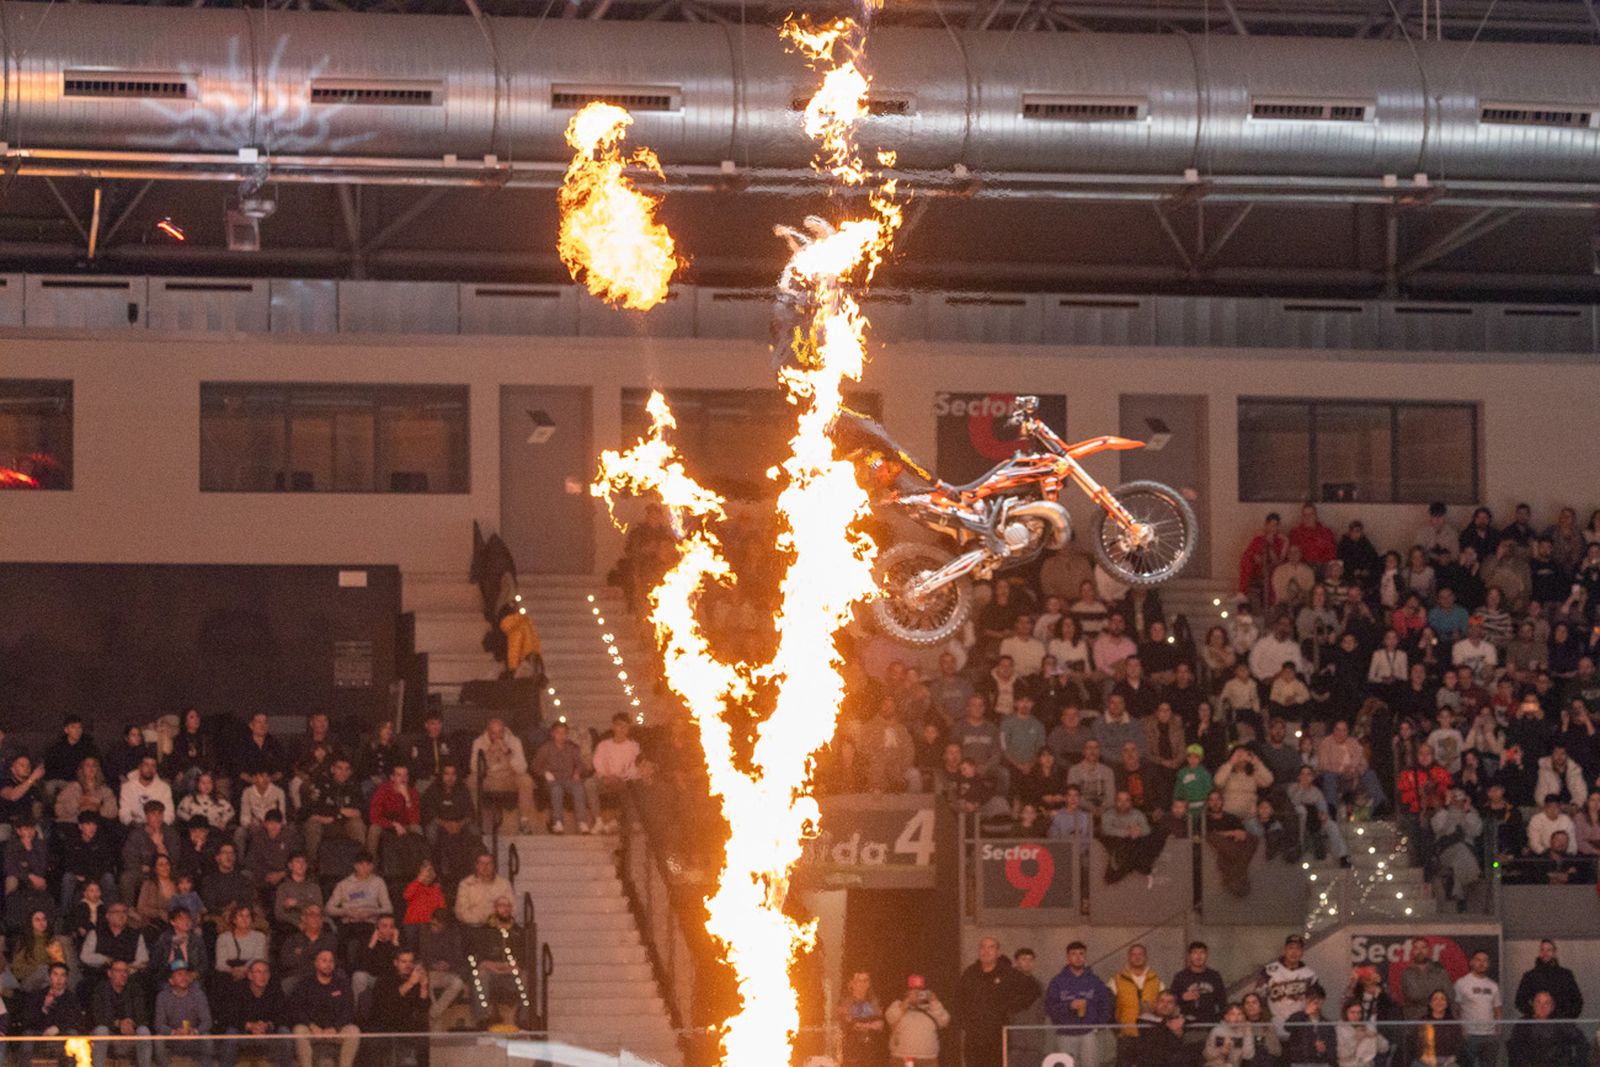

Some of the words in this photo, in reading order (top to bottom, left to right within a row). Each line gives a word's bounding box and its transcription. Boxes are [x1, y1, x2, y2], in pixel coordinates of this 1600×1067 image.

[894, 809, 937, 866] 4
[982, 843, 1040, 860] Sector
[1005, 842, 1054, 909] 9
[1351, 937, 1448, 963] Sectr
